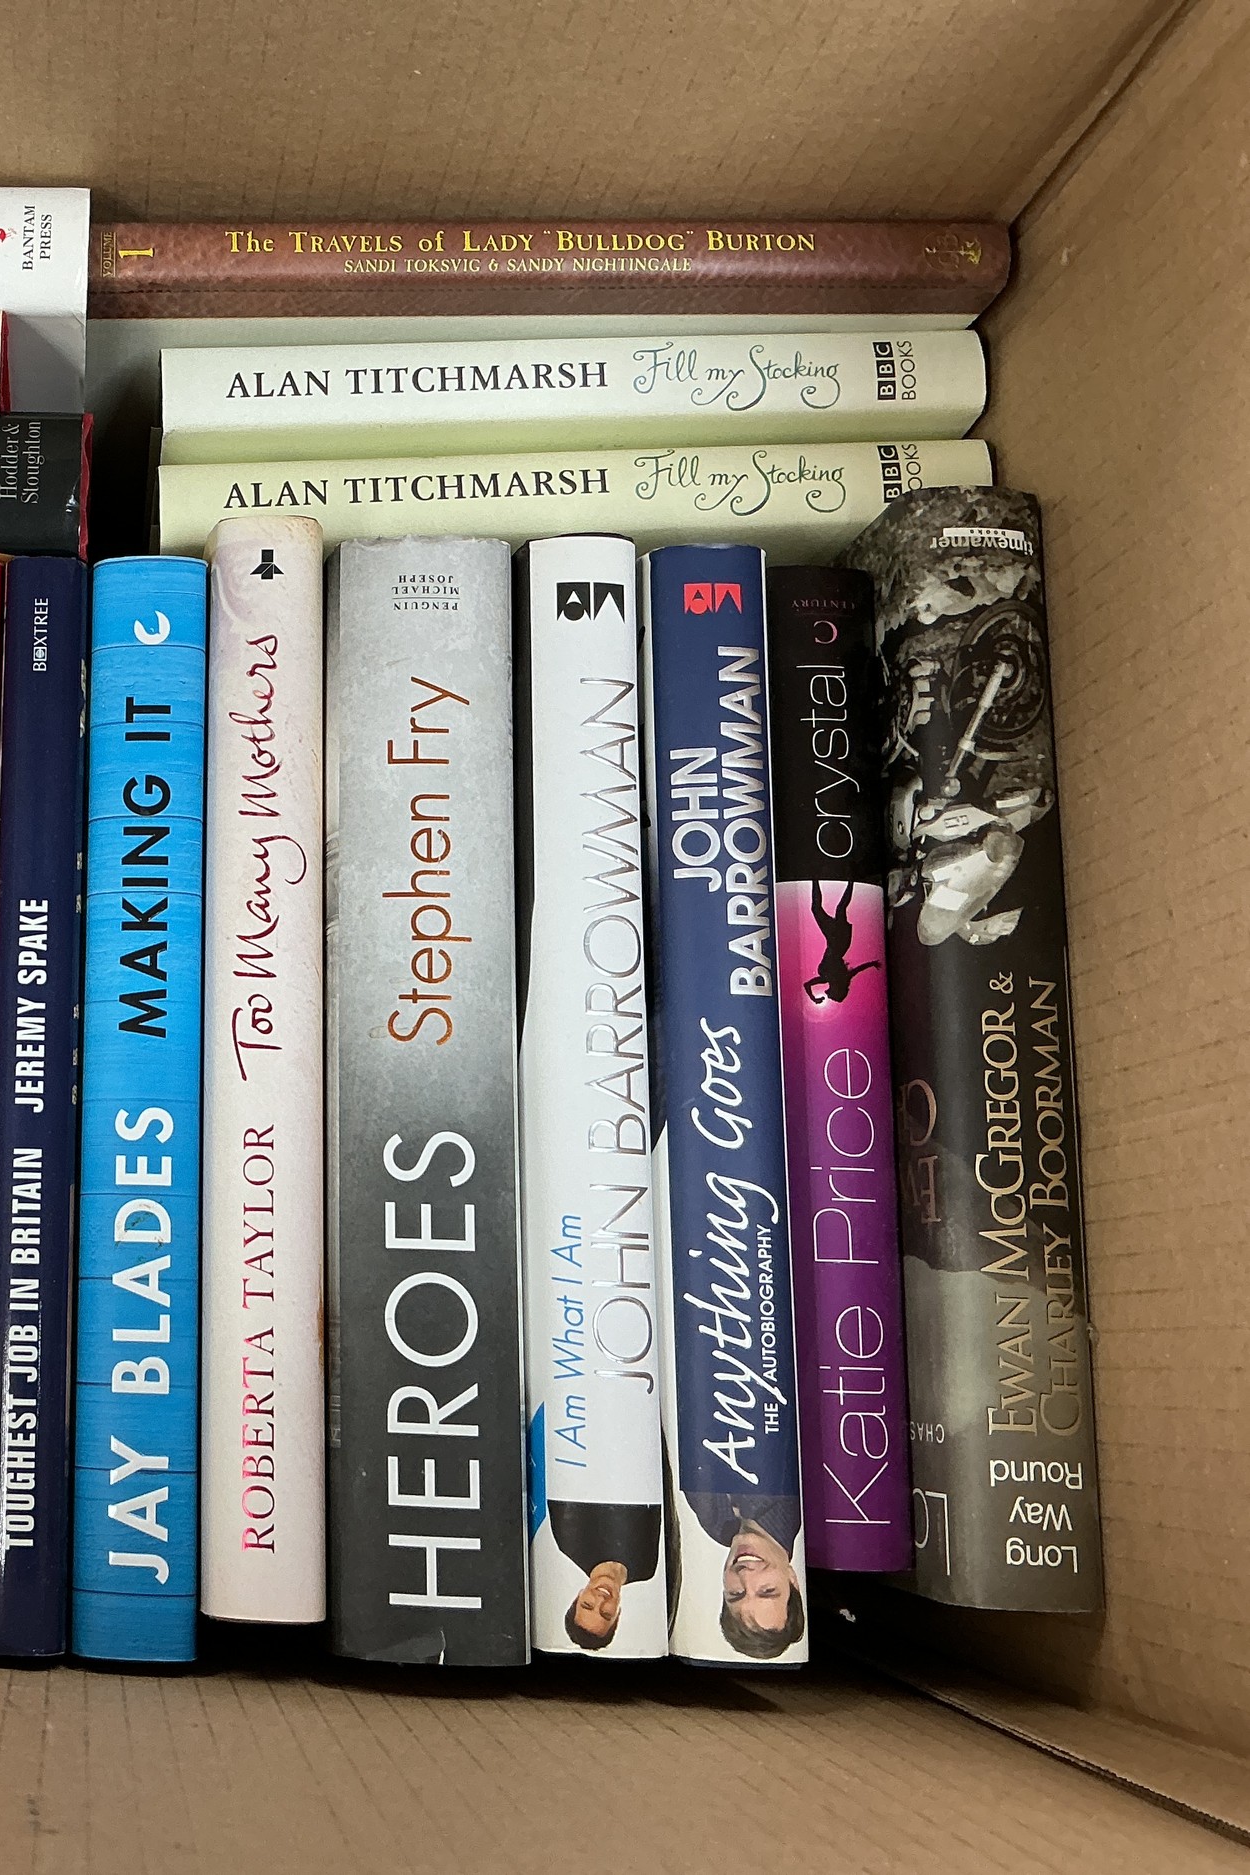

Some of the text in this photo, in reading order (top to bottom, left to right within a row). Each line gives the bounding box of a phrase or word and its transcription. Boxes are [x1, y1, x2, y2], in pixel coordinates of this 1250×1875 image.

[21, 205, 37, 271] BANTAM
[39, 214, 52, 260] PRESS
[103, 232, 113, 277] VOLUME
[119, 247, 153, 258] 1
[224, 231, 275, 254] The
[288, 230, 403, 254] TRAVELS
[418, 230, 445, 253] of
[462, 230, 533, 252] LADY
[707, 229, 816, 252] BURTON
[344, 256, 693, 274] SANDI TOKSVIG & SANDY NIGHTINGALE
[225, 341, 841, 412] ALAN TITCHMARSH Fill my Stocking
[874, 342, 896, 400] BBC
[897, 340, 916, 400] BOOKS
[0, 424, 20, 499] Hodder &
[21, 422, 45, 503] Stoughton
[224, 448, 846, 516] ALAN TITCHMARSH Fill my Stocking
[877, 445, 902, 503] BBC
[901, 443, 922, 491] OOKS
[399, 575, 454, 583] JOSEPH
[930, 536, 1034, 556] timewarner
[392, 586, 459, 594] MICHAEL
[393, 602, 458, 610] PENGUIN
[797, 664, 860, 861] crystal
[669, 746, 722, 893] JOHN
[717, 645, 774, 998] BARROWMAN
[228, 633, 307, 1081] Too Many Mothers
[382, 676, 472, 1046] Stephen Fry
[989, 971, 1015, 995] &
[579, 677, 654, 1395] JOHN BARROWMAN
[108, 695, 174, 1586] JAY BLADES MAKING IT
[5, 899, 48, 1547] TOUGHEST JOB IN BRITAIN JEREMY SPAKE
[1029, 976, 1084, 1438] CHARLEY BOORMAN
[682, 1016, 789, 1485] Anything Goes
[809, 1046, 892, 1527] Katie Price
[241, 1123, 275, 1554] ROBERTA TAYLOR
[550, 1214, 586, 1467] I Am What I Am
[756, 1223, 779, 1434] THE AUTOBIOGRAPHY
[382, 1130, 482, 1609] HEROES
[987, 1295, 1039, 1437] EWAN
[989, 1459, 1083, 1492] Round
[1008, 1495, 1073, 1533] Way
[1006, 1540, 1079, 1574] Long
